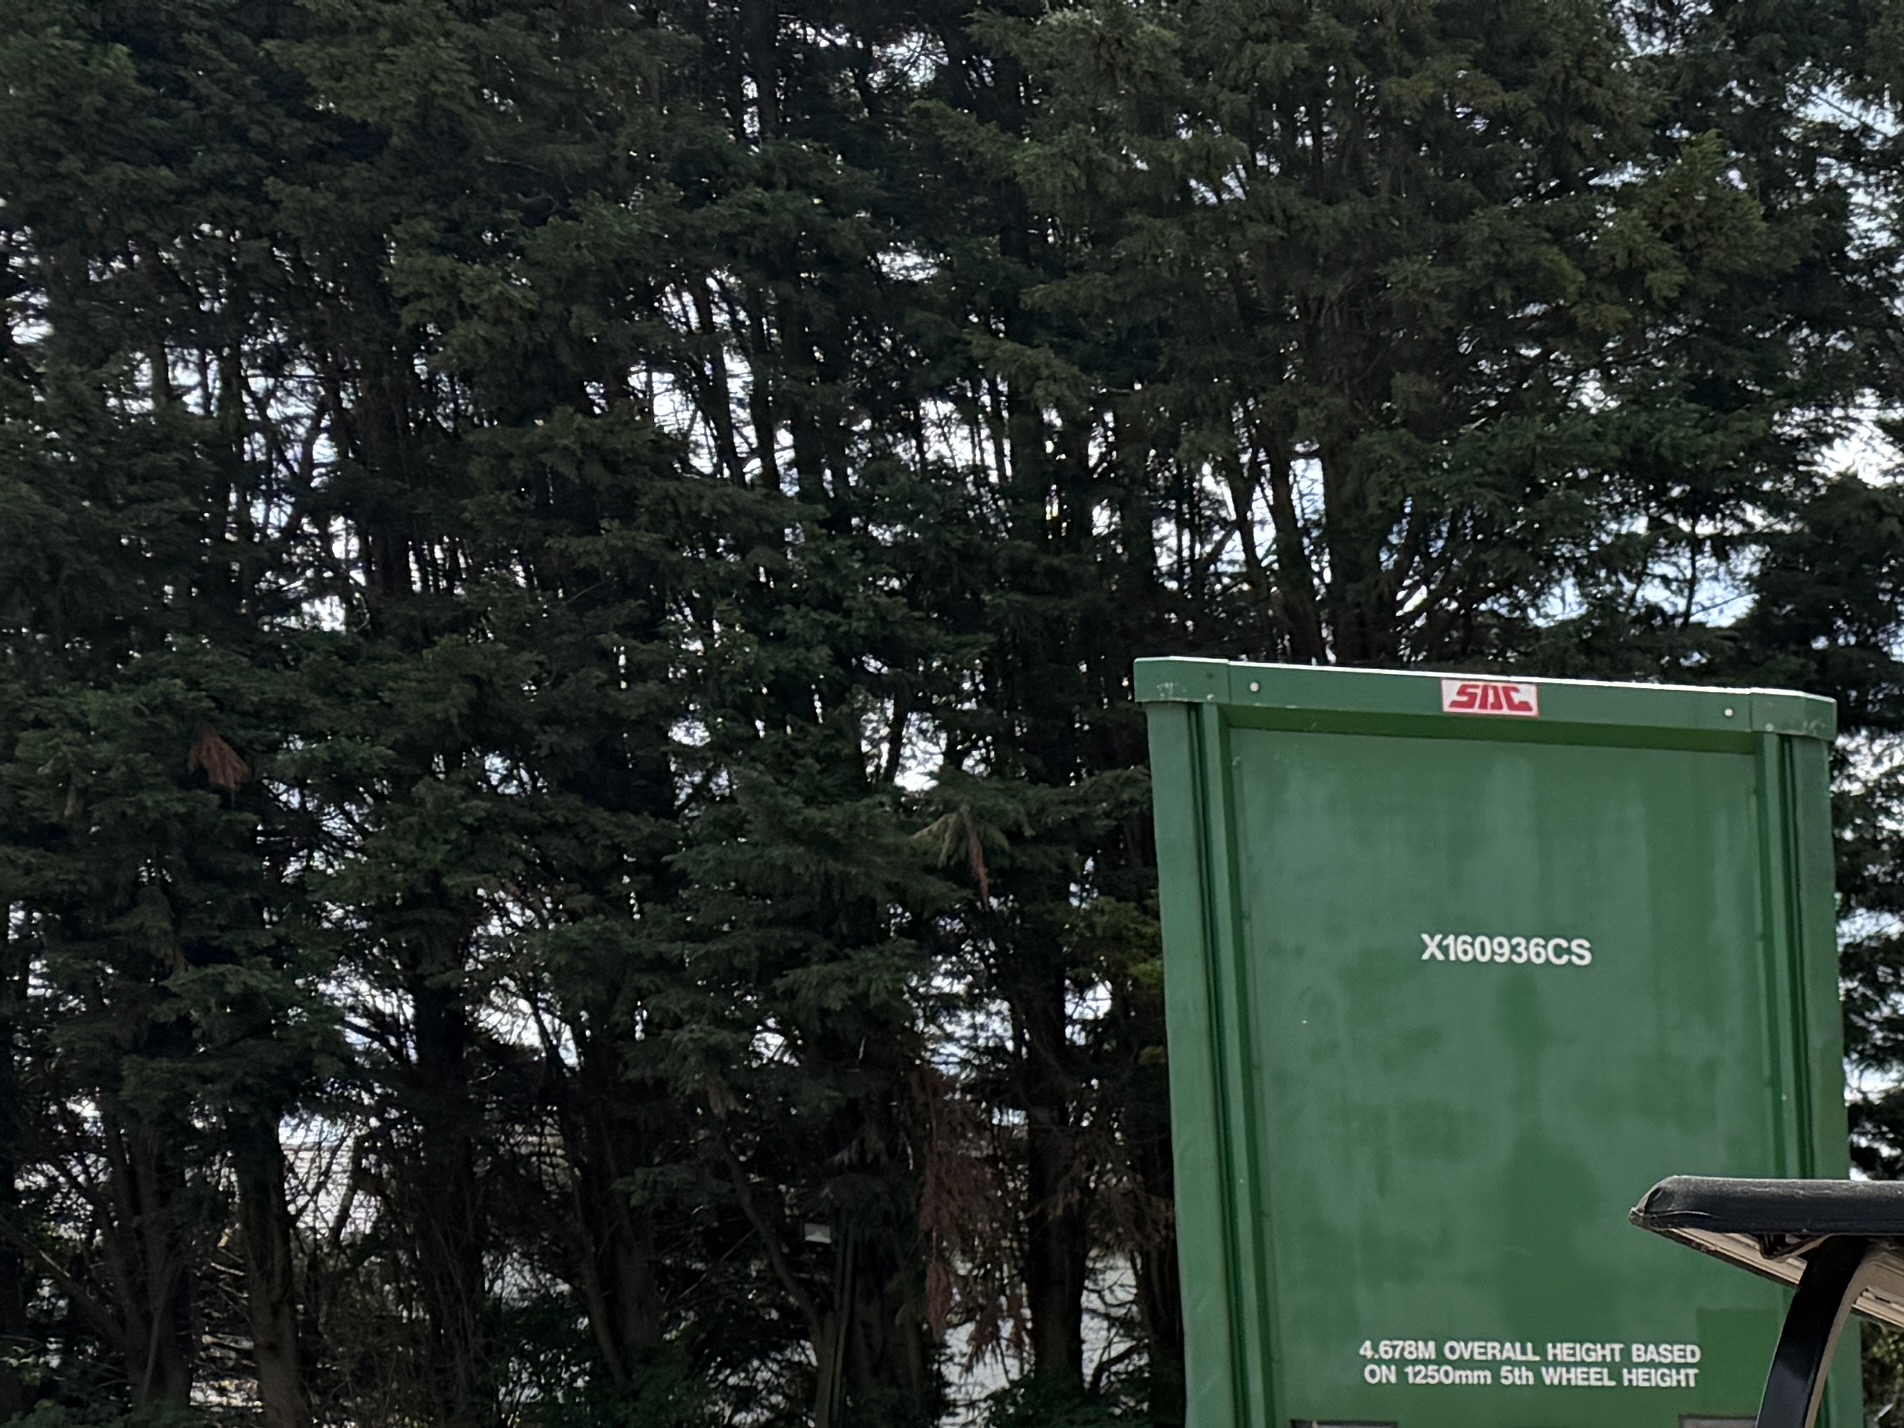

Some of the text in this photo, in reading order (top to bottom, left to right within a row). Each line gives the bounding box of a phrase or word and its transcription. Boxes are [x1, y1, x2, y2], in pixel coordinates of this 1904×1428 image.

[1420, 933, 1592, 966] X160936CS
[1359, 1340, 1701, 1363] 4.678M OVERALL HEIGHT BASED
[1364, 1364, 1699, 1388] ON 1250mm 5th WHEEL HEIGHT
